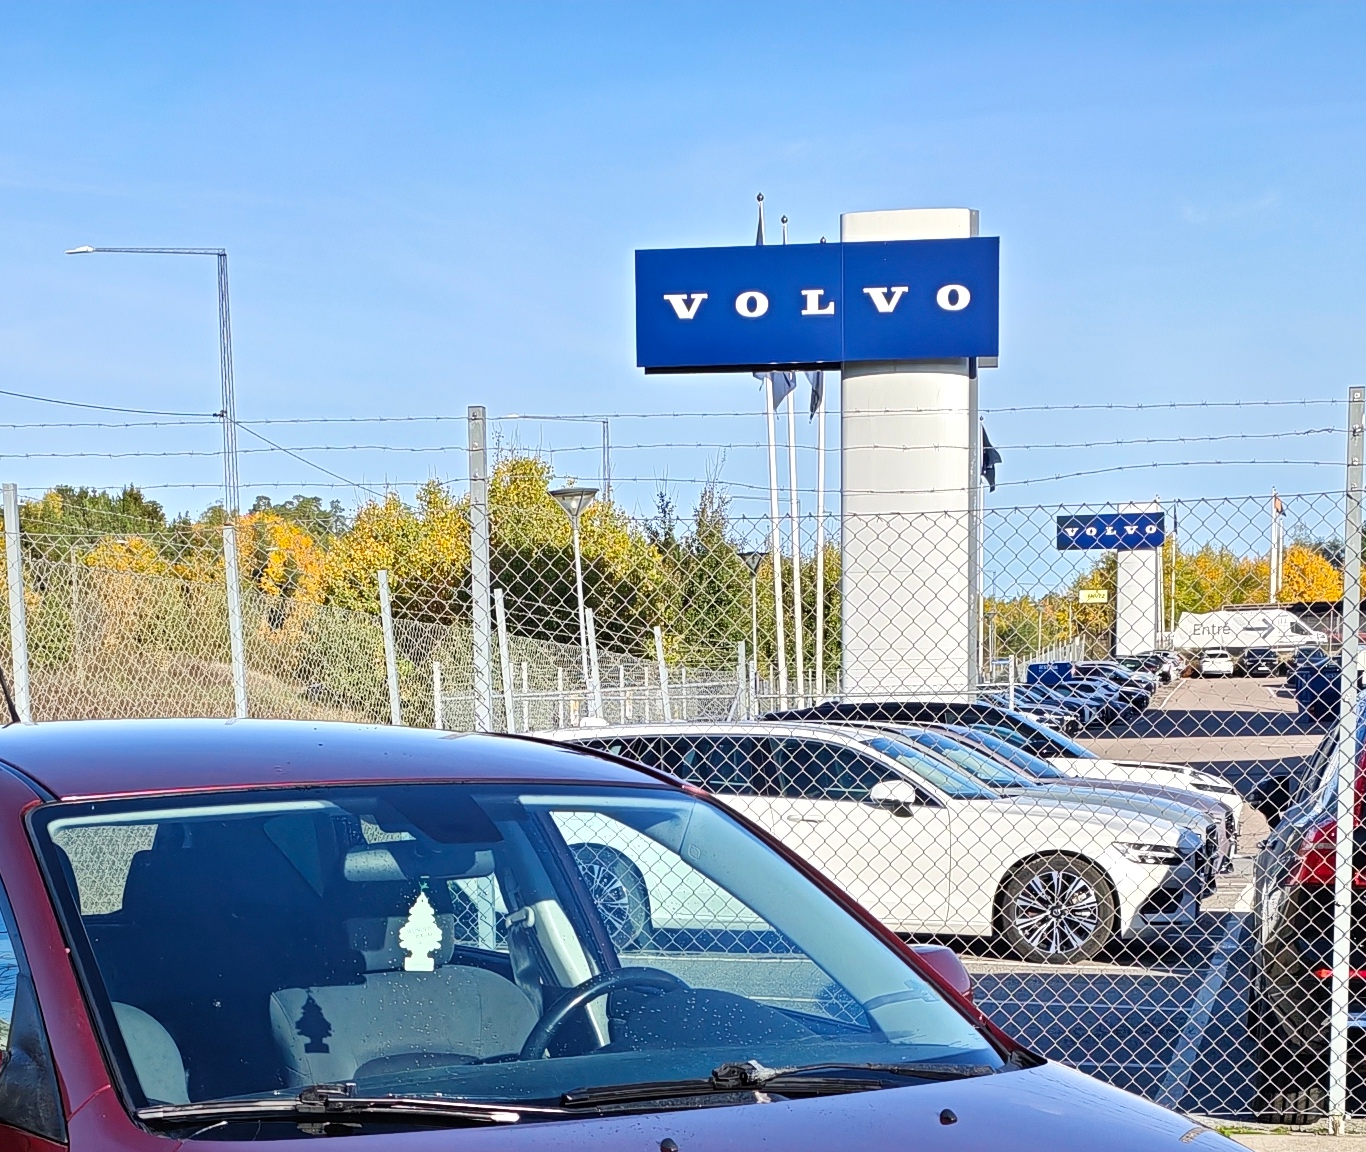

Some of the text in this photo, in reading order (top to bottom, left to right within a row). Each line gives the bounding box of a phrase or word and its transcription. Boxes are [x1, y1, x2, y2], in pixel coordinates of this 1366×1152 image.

[663, 284, 971, 320] VOLVO
[1065, 525, 1157, 537] VOLVO
[1193, 622, 1231, 636] Entré
